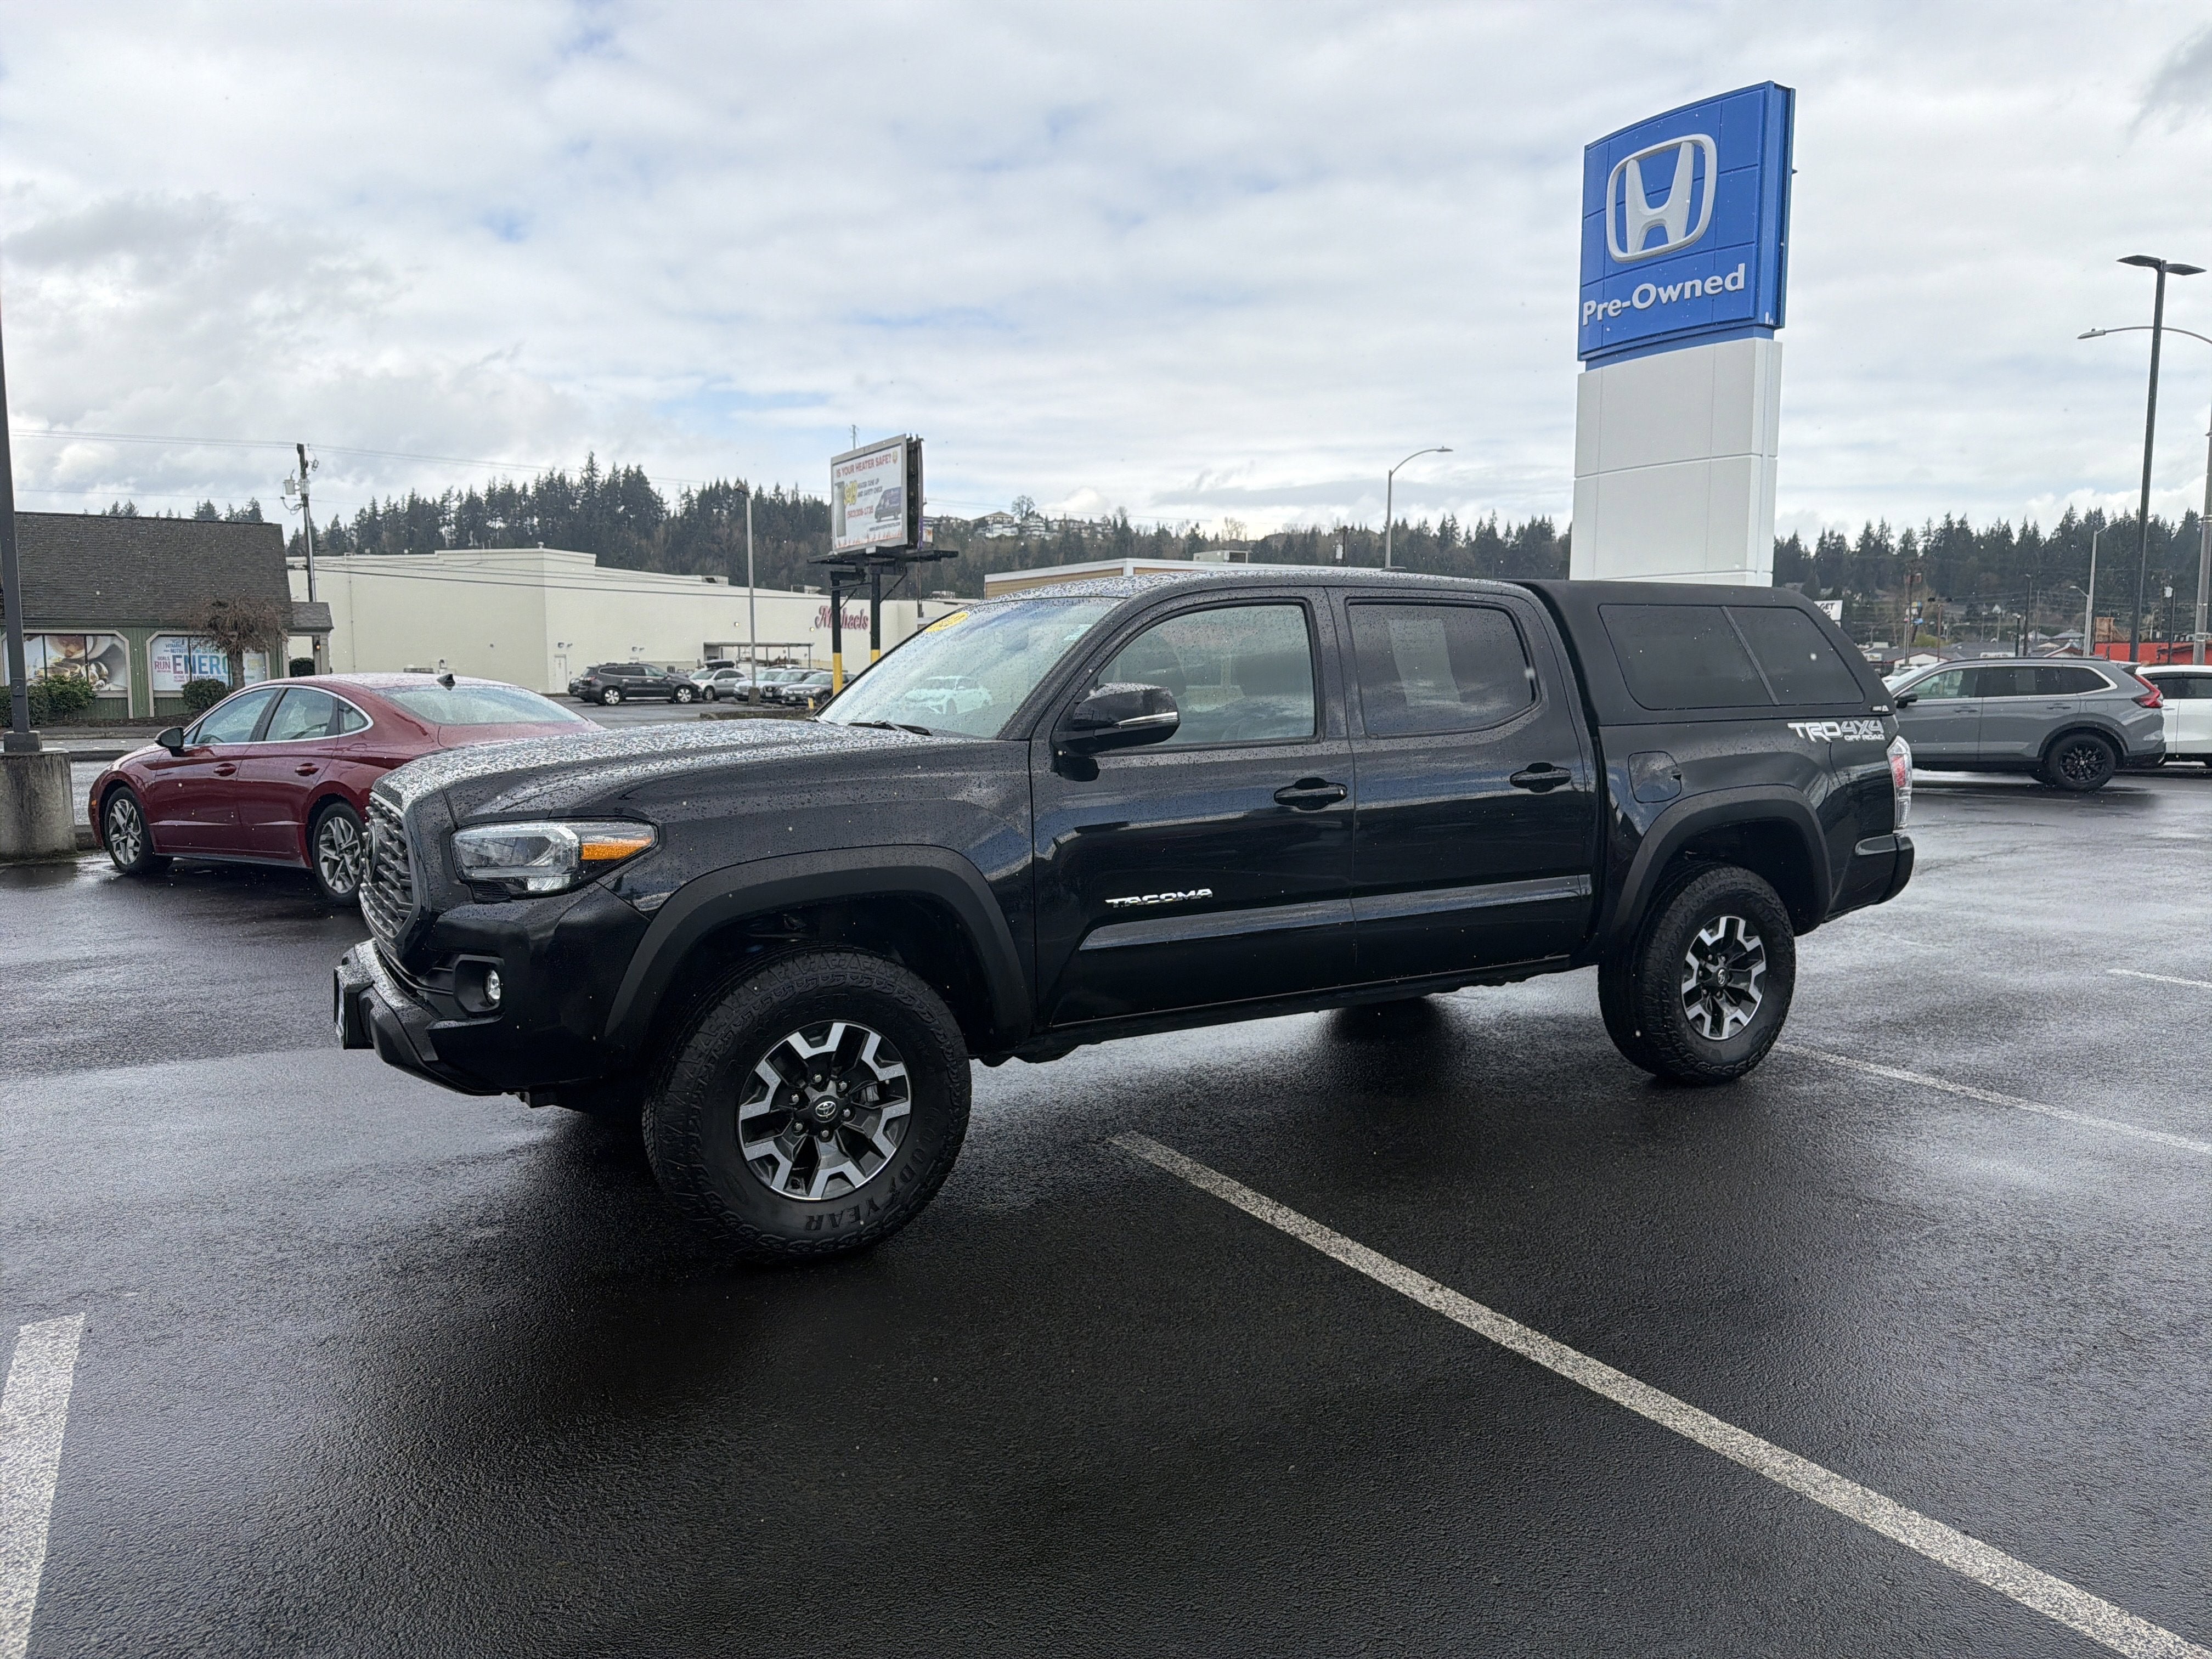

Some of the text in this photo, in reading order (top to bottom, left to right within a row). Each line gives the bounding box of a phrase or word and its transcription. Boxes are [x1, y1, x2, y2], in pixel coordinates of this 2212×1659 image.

[1582, 263, 1745, 326] Pre-Owned
[837, 453, 891, 477] IS YOUR HEATER SAFE?
[815, 606, 868, 630] Mhaels
[154, 661, 171, 670] RUN
[1787, 721, 1843, 742] TRD
[1105, 888, 1214, 908] TACOMA
